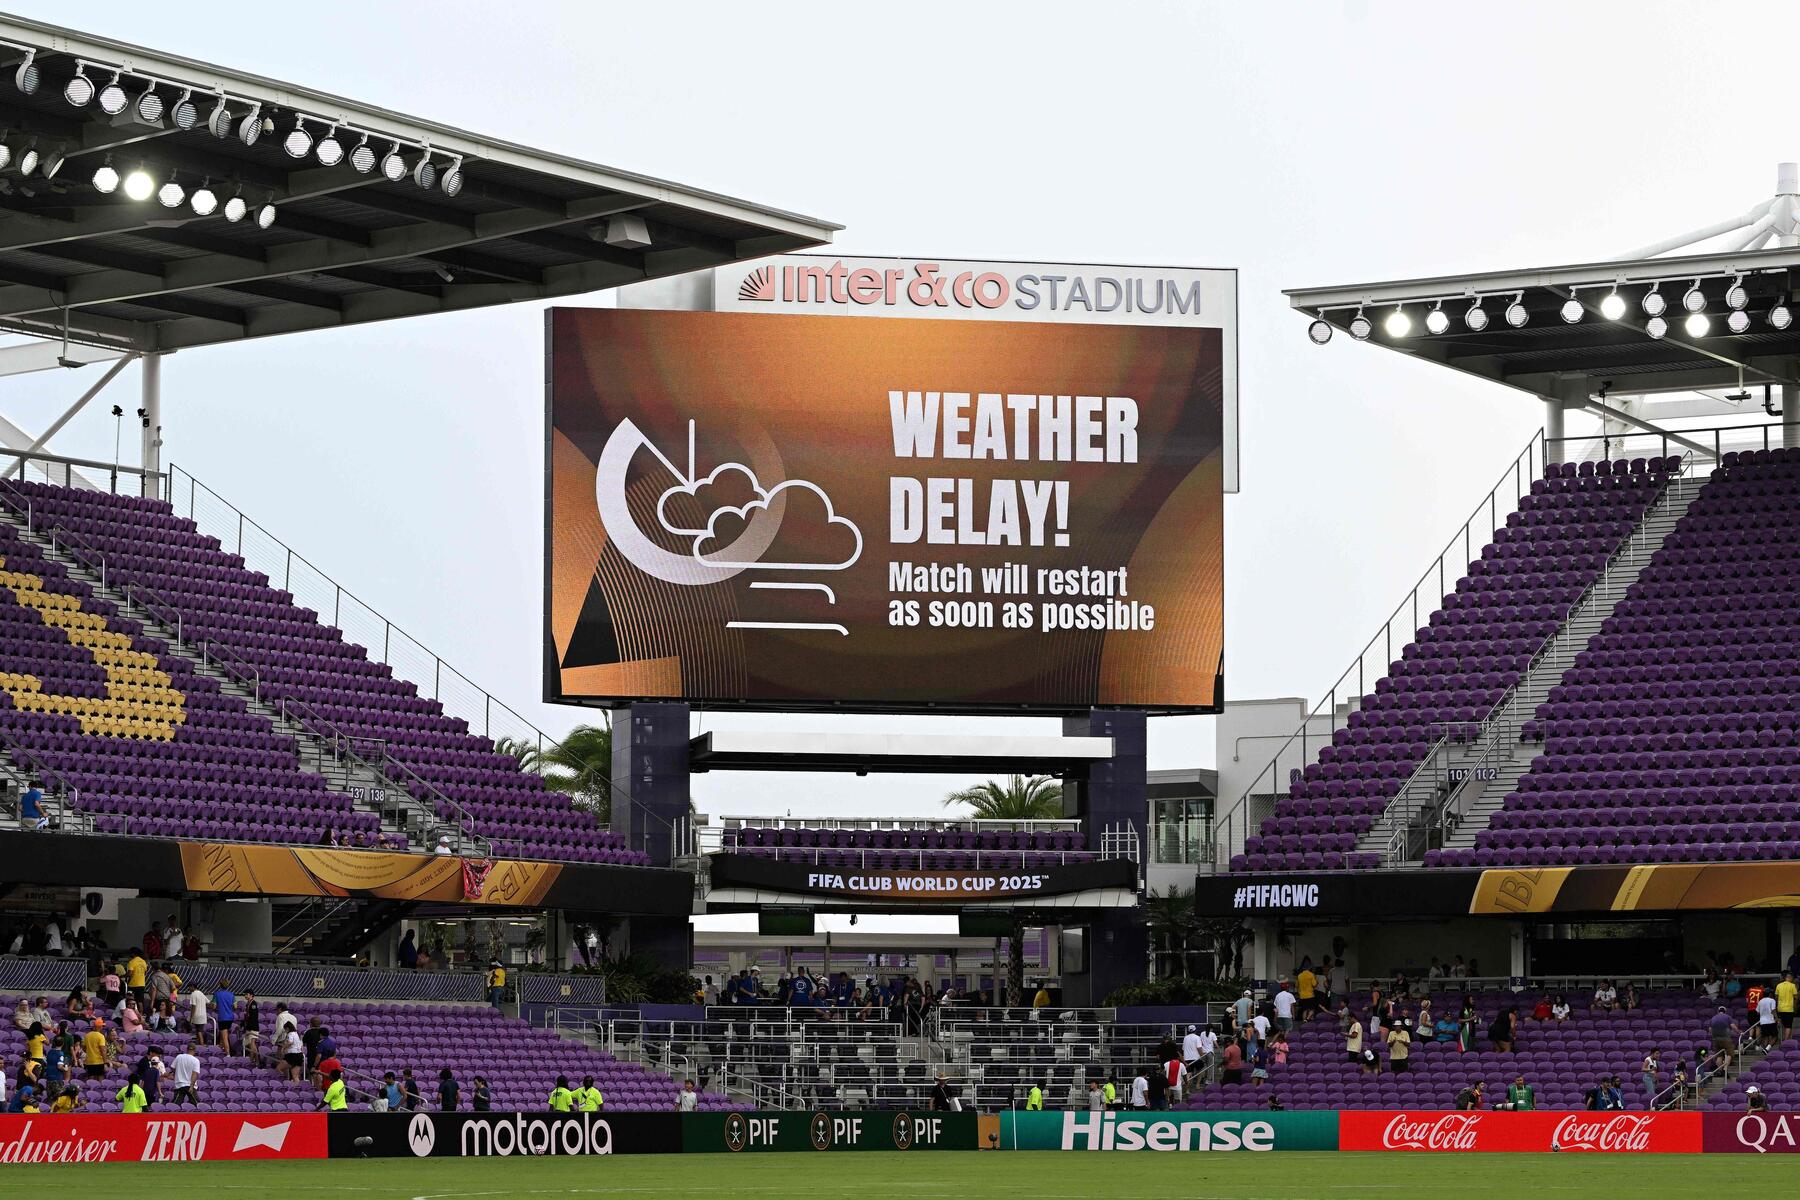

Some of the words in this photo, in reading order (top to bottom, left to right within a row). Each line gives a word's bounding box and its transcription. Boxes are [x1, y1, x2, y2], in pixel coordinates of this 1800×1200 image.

[1015, 274, 1201, 315] STADIUM
[888, 390, 1139, 464] WEATHER
[889, 476, 1070, 547] DELAY!
[889, 562, 972, 593] Match
[982, 562, 1028, 594] will
[1037, 565, 1128, 597] restart
[888, 600, 920, 626] as
[928, 600, 993, 628] soon
[1002, 602, 1034, 628] as
[1042, 599, 1155, 633] possible
[350, 787, 364, 799] 137
[370, 789, 385, 801] 138
[808, 873, 845, 889] FIFA
[849, 876, 892, 891] CLUB
[895, 876, 958, 891] WORLD
[961, 877, 996, 891] CUP
[1233, 884, 1319, 908] #FIFACWC
[141, 1120, 207, 1162] ZERO
[462, 1112, 613, 1156] motorola
[749, 1118, 779, 1145] PIF
[834, 1118, 862, 1144] PIF
[915, 1118, 942, 1143] PIF
[1061, 1111, 1275, 1151] Hisense
[1383, 1113, 1483, 1150] Coca-Cola
[1553, 1113, 1656, 1150] Coca-Cola
